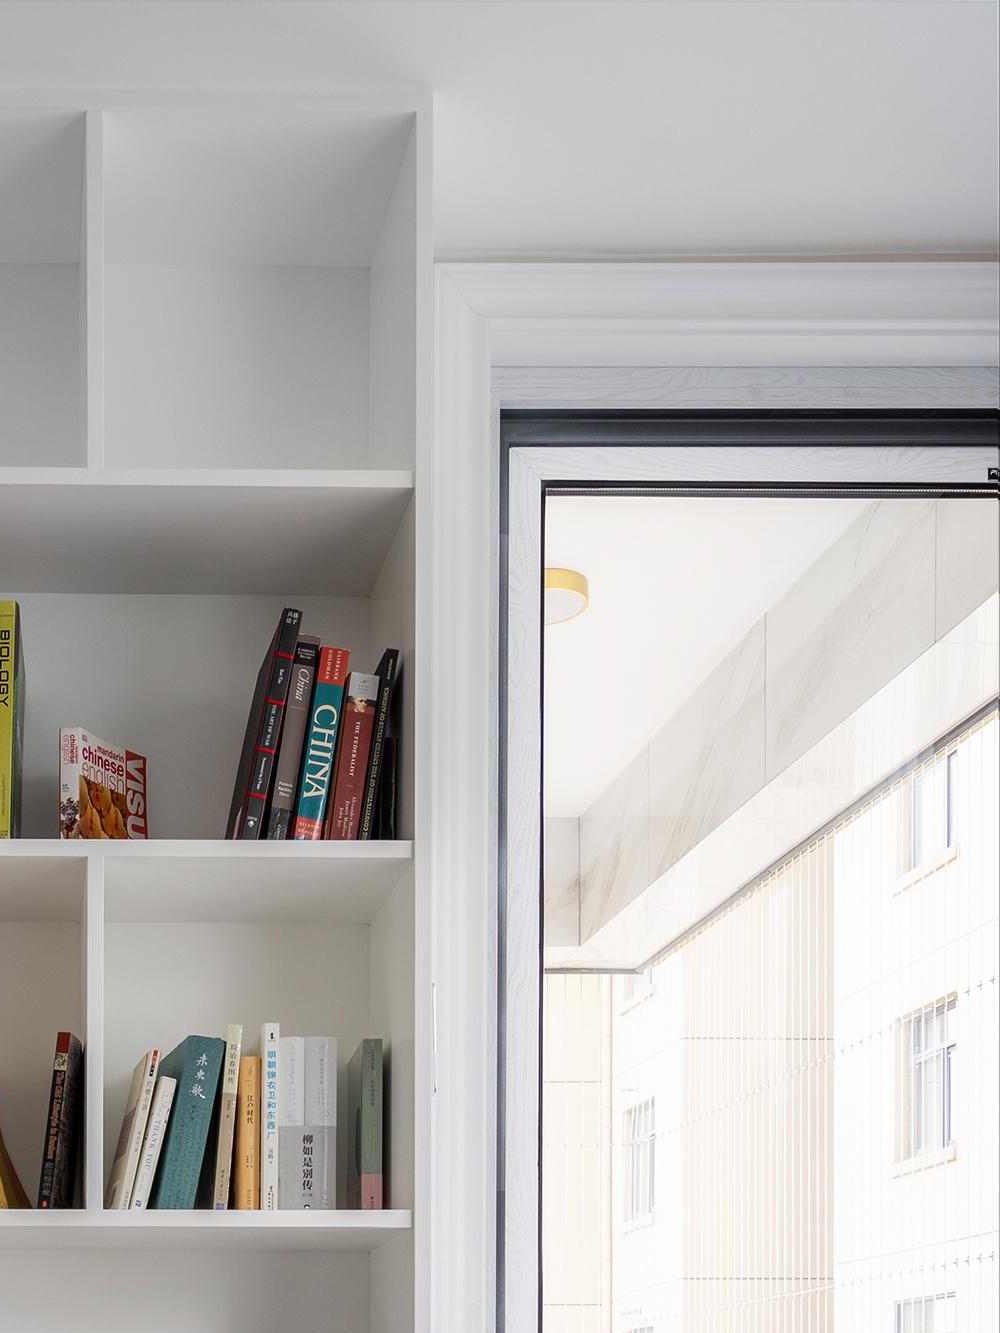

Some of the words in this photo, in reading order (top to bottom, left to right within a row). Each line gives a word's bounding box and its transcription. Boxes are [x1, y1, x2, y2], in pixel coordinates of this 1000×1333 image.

[325, 649, 333, 680] GOLDMAN
[333, 651, 342, 680] FAIRBANK
[295, 668, 310, 701] China
[82, 746, 124, 777] chinese
[97, 746, 125, 762] mandarin
[303, 704, 337, 798] CHINA
[349, 733, 359, 776] FEDERALIST
[82, 762, 125, 795] english
[148, 1119, 161, 1150] THANK
[145, 1154, 153, 1169] YOU
